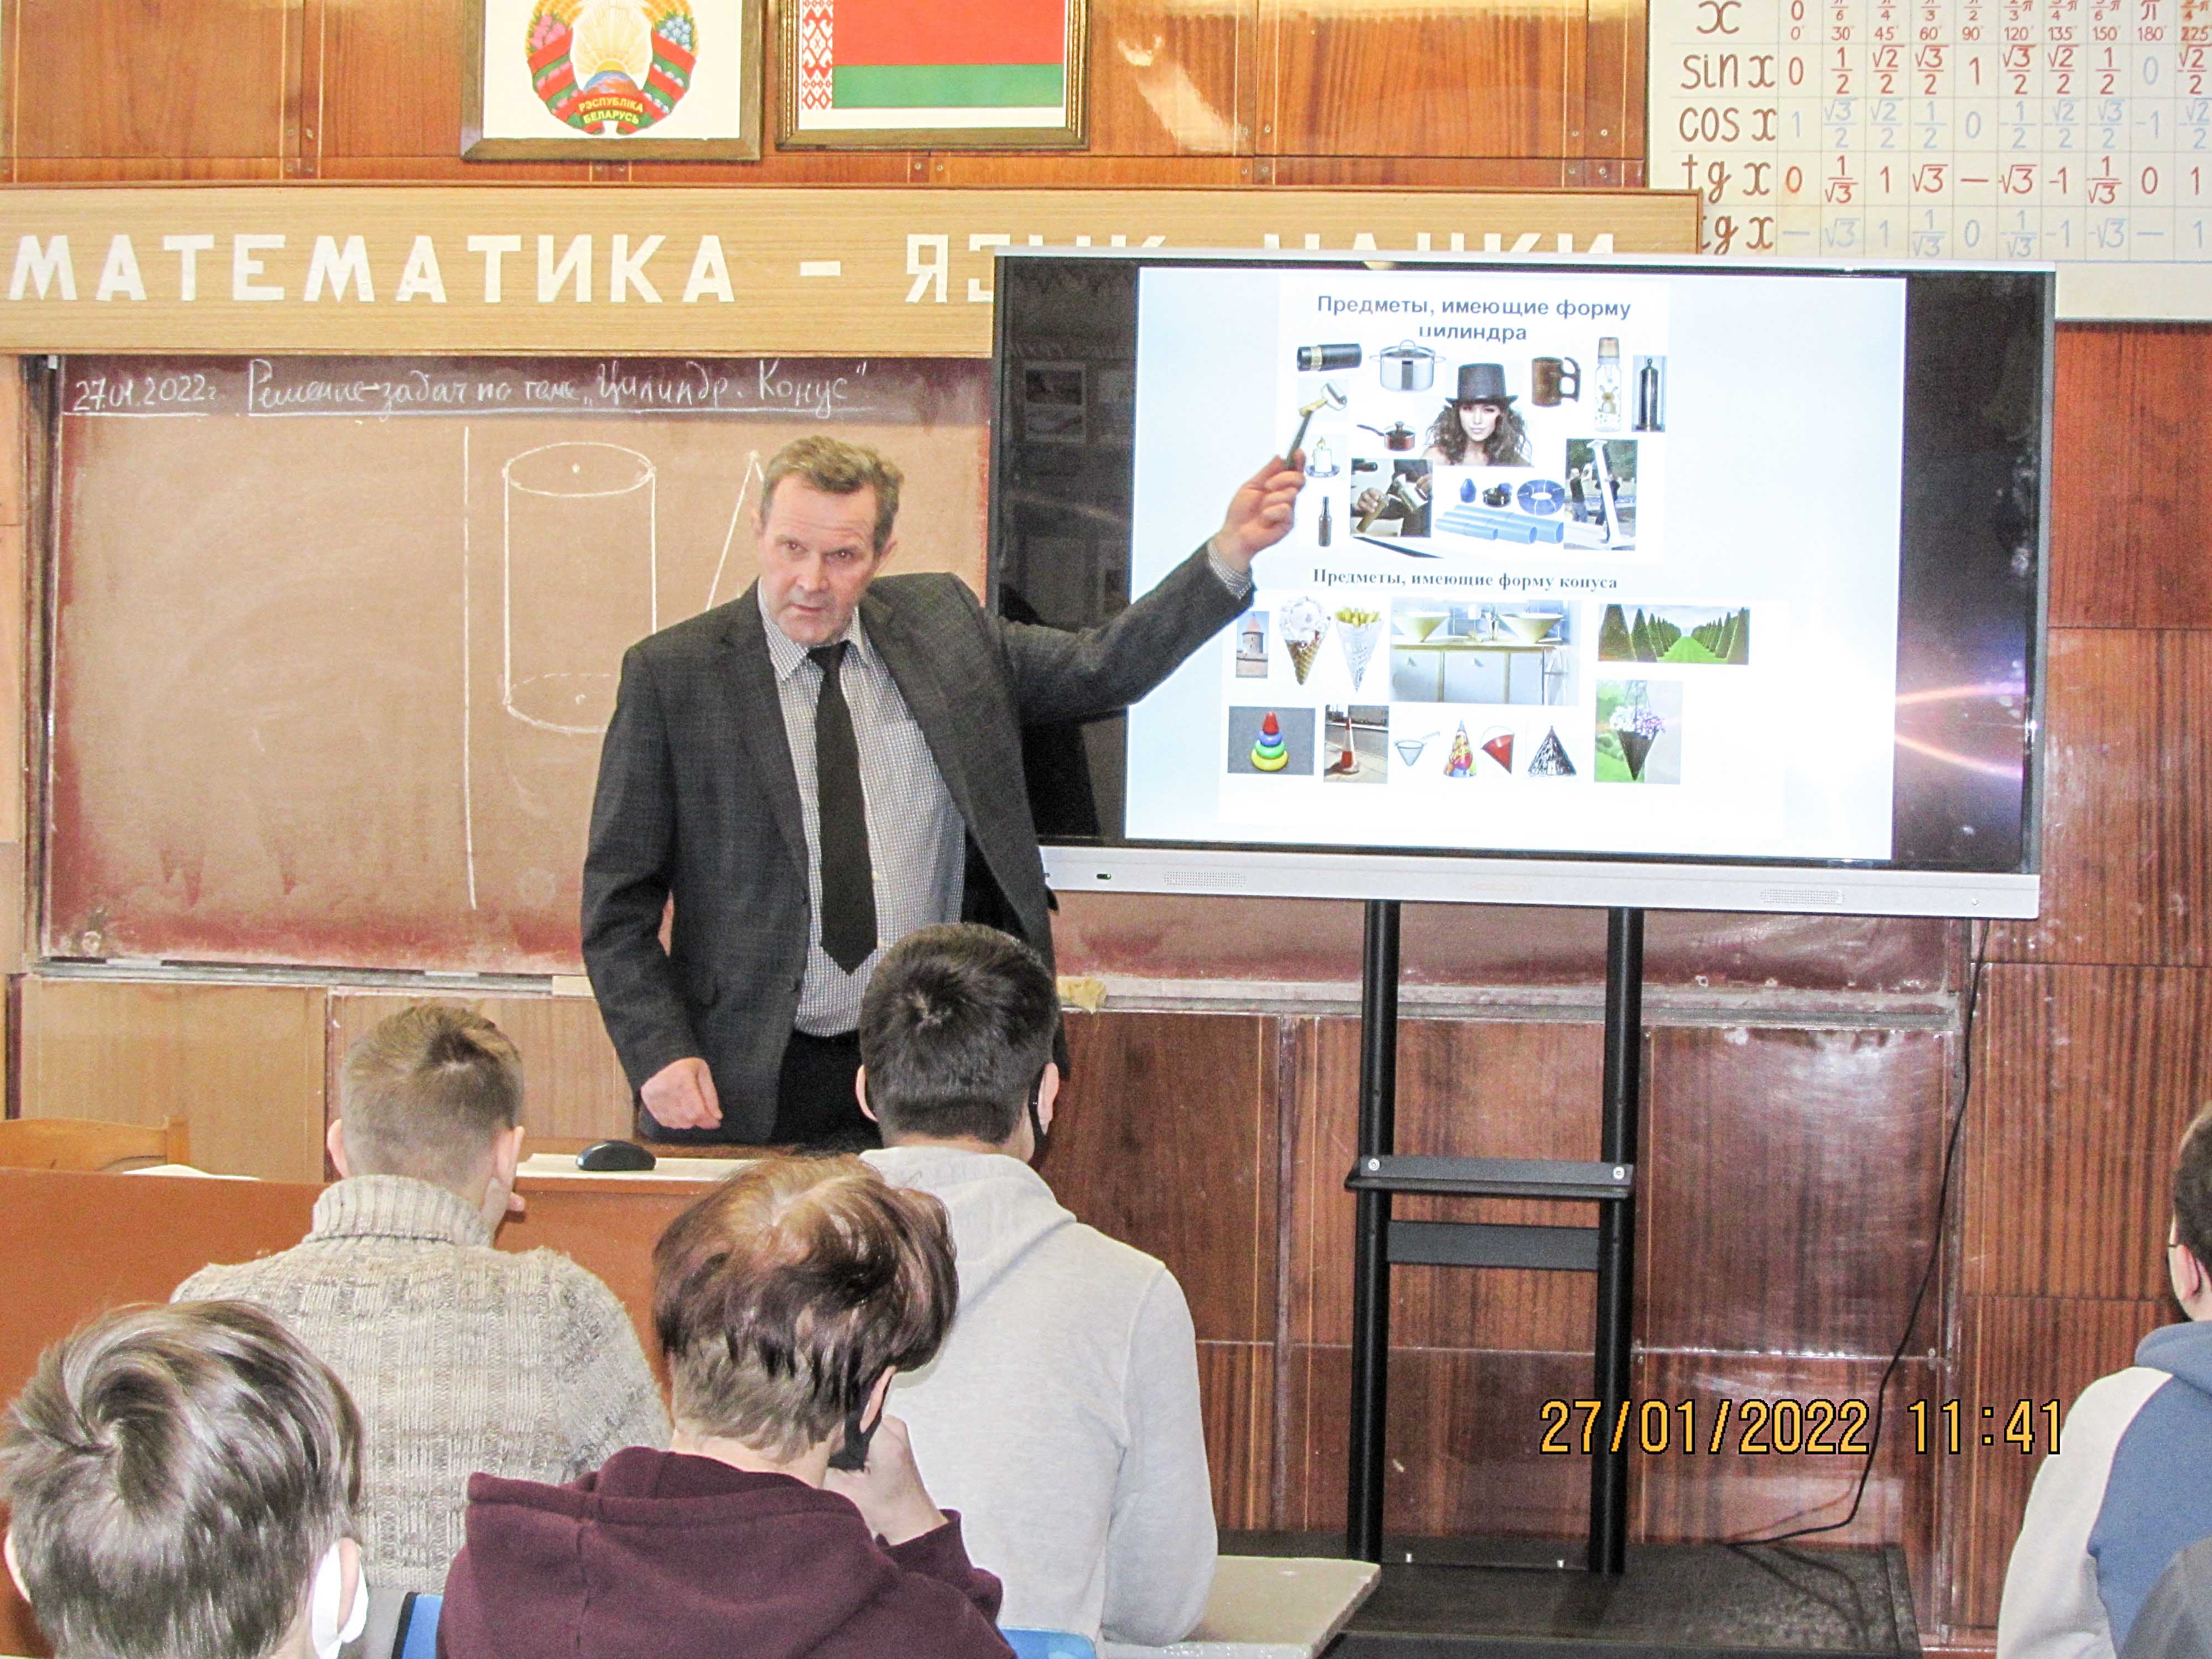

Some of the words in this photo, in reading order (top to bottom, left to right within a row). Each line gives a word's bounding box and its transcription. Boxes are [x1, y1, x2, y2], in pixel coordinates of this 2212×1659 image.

[1681, 54, 1738, 90] sin
[579, 97, 643, 112] РЭСПУБЛІКА
[584, 111, 639, 124] БЕЛАРУСЬ
[1679, 107, 1740, 142] cos
[8, 234, 735, 304] МАТЕМАТИКА
[1317, 295, 1434, 316] Предметы,
[1442, 301, 1548, 317] имеющие
[1556, 299, 1631, 320] форму
[1419, 325, 1527, 344] цилиндра
[1313, 568, 1405, 586] Предметы,
[1411, 573, 1493, 587] имеющие
[1499, 573, 1554, 590] форму
[1559, 578, 1618, 592] конуса
